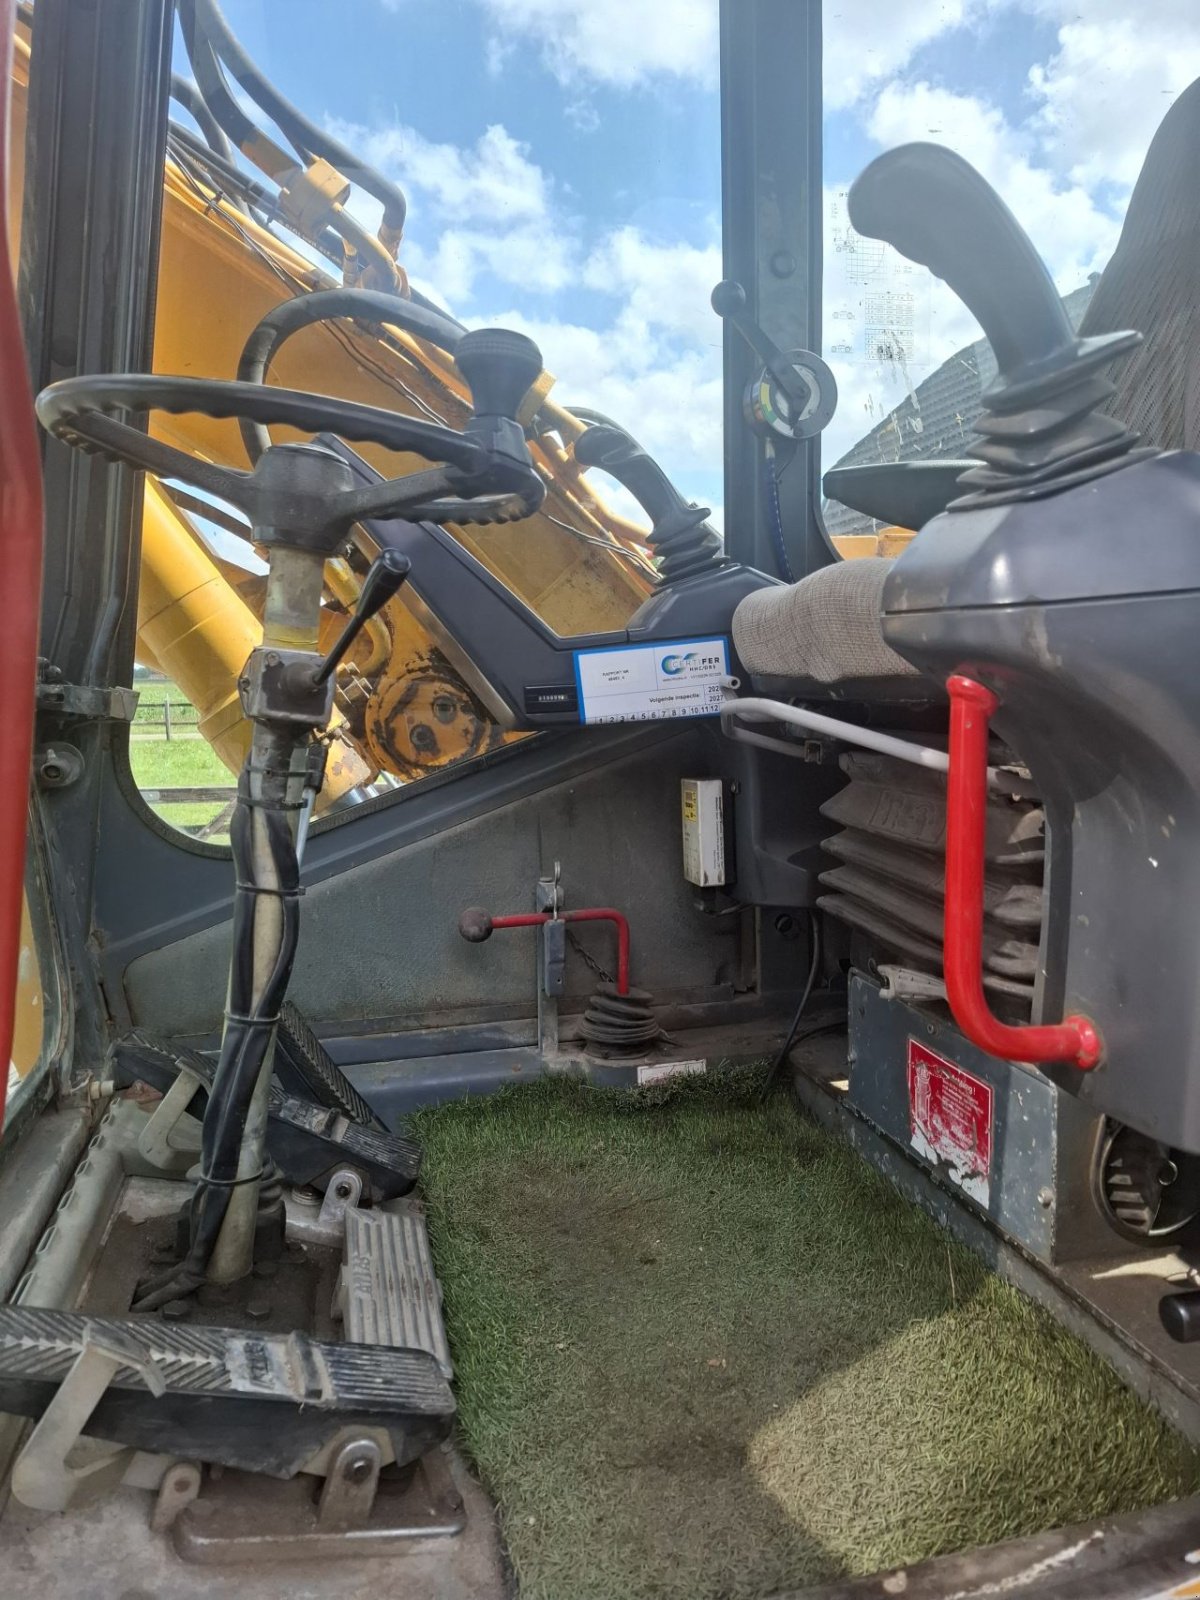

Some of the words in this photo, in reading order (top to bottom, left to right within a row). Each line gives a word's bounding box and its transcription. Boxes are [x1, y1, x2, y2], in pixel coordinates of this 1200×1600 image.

[708, 685, 720, 693] 202
[649, 695, 674, 704] Volgende
[709, 694, 724, 702] 2027
[641, 712, 646, 720] 5
[651, 711, 656, 719] 6
[661, 710, 667, 718] 7
[671, 709, 677, 717] 8
[690, 706, 699, 714] 10
[710, 704, 719, 712] 12
